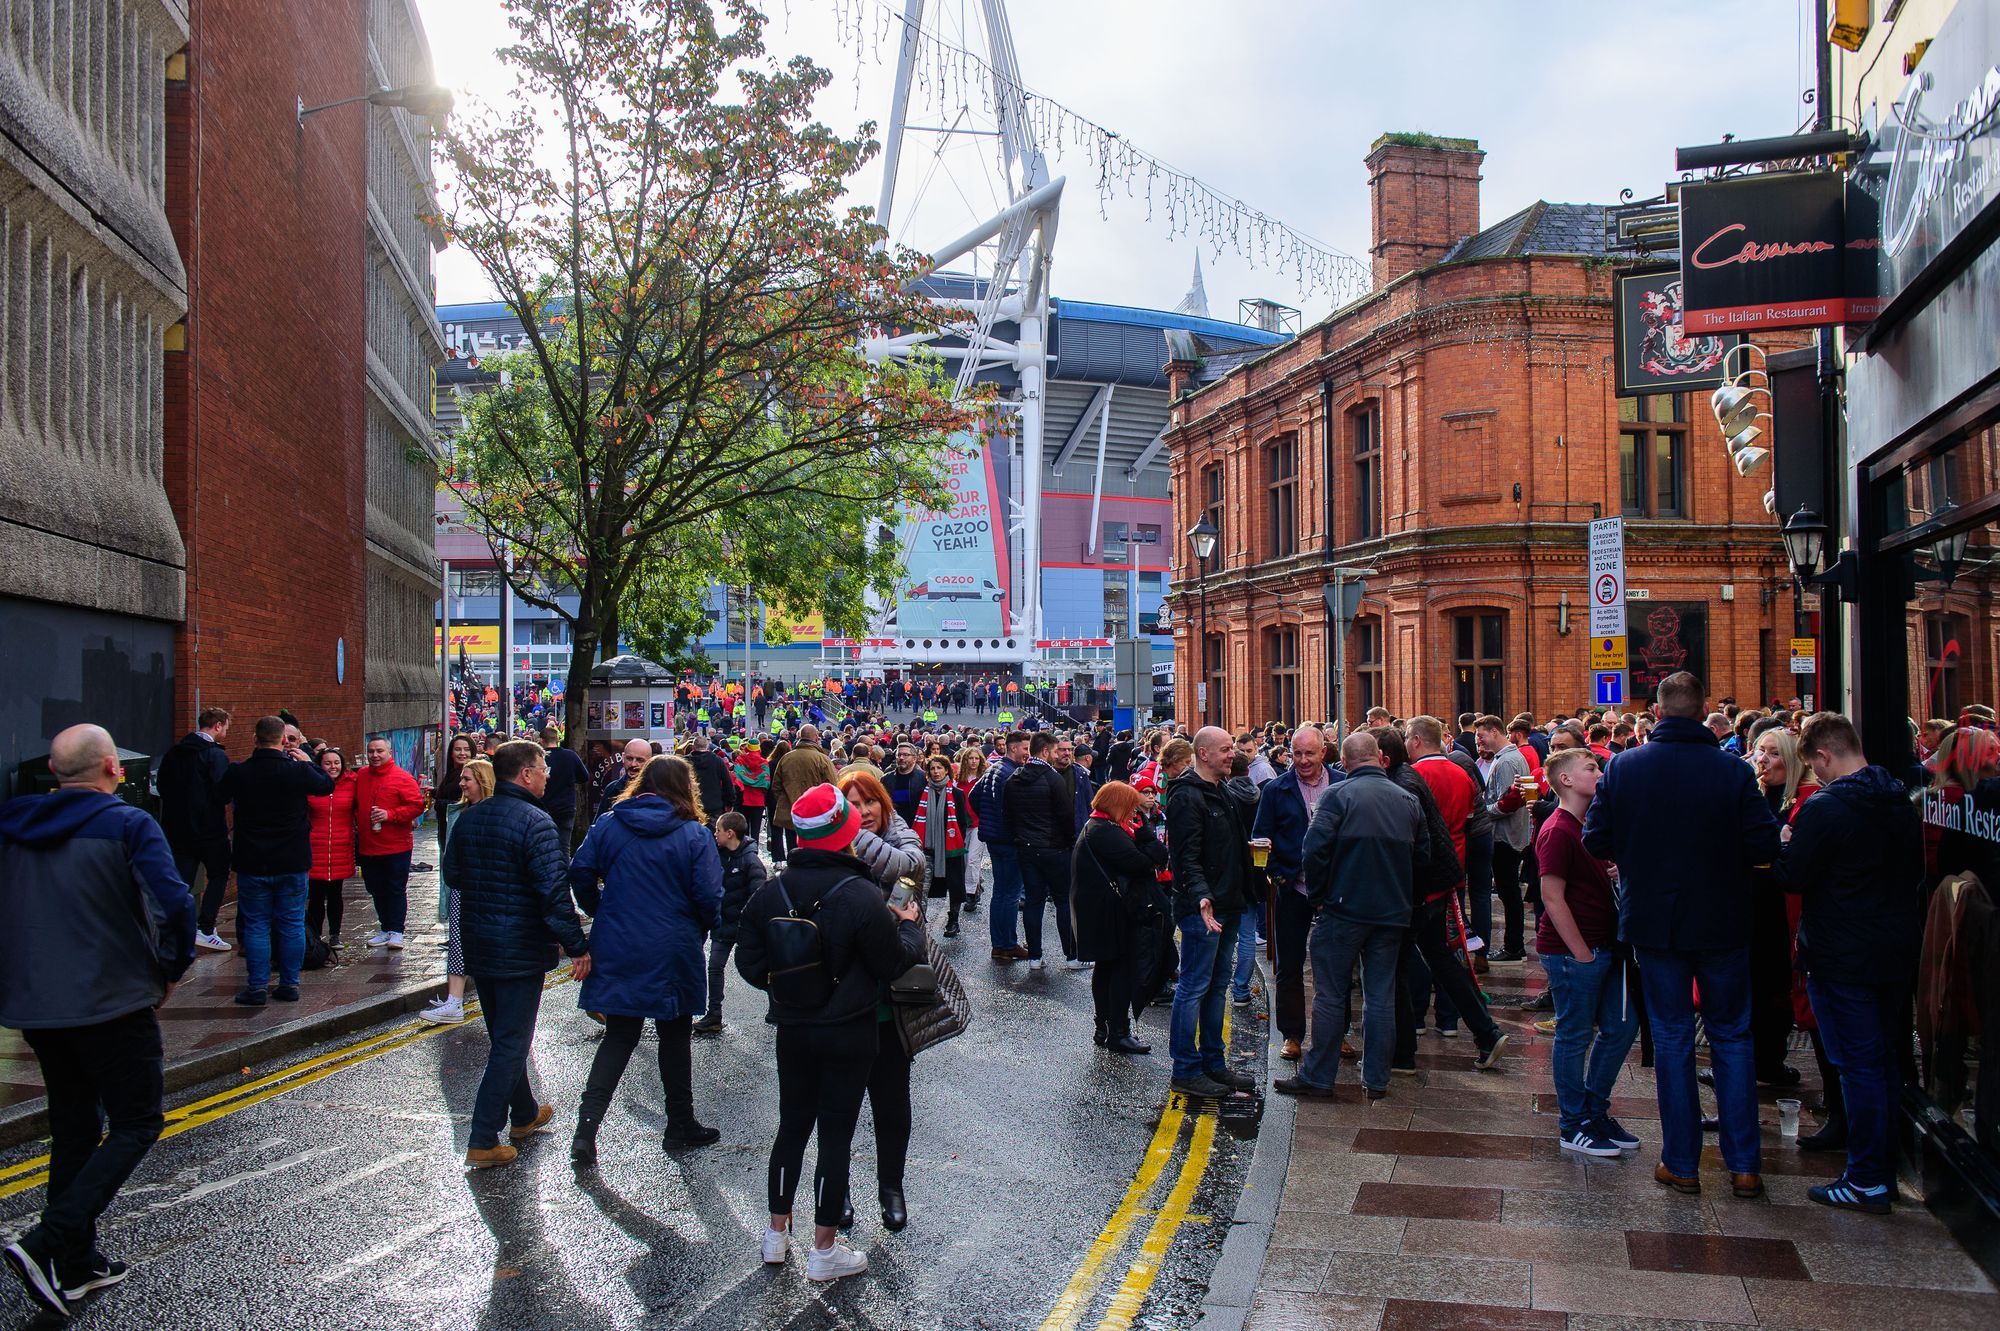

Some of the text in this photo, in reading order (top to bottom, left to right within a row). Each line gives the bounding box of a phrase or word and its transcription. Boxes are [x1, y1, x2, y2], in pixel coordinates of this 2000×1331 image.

[1692, 223, 1835, 270] Casanova
[1703, 305, 1827, 326] The Italian Restaurant
[948, 504, 987, 519] CAR?
[931, 520, 989, 537] CAZOO
[1594, 521, 1618, 531] PARTH
[933, 536, 978, 552] YEAH!
[1592, 547, 1621, 555] PEDESTRIAN
[1595, 562, 1617, 571] ZONE
[935, 575, 974, 584] CAZOO
[593, 752, 623, 787] POSSIB
[1922, 786, 1961, 832] Italian
